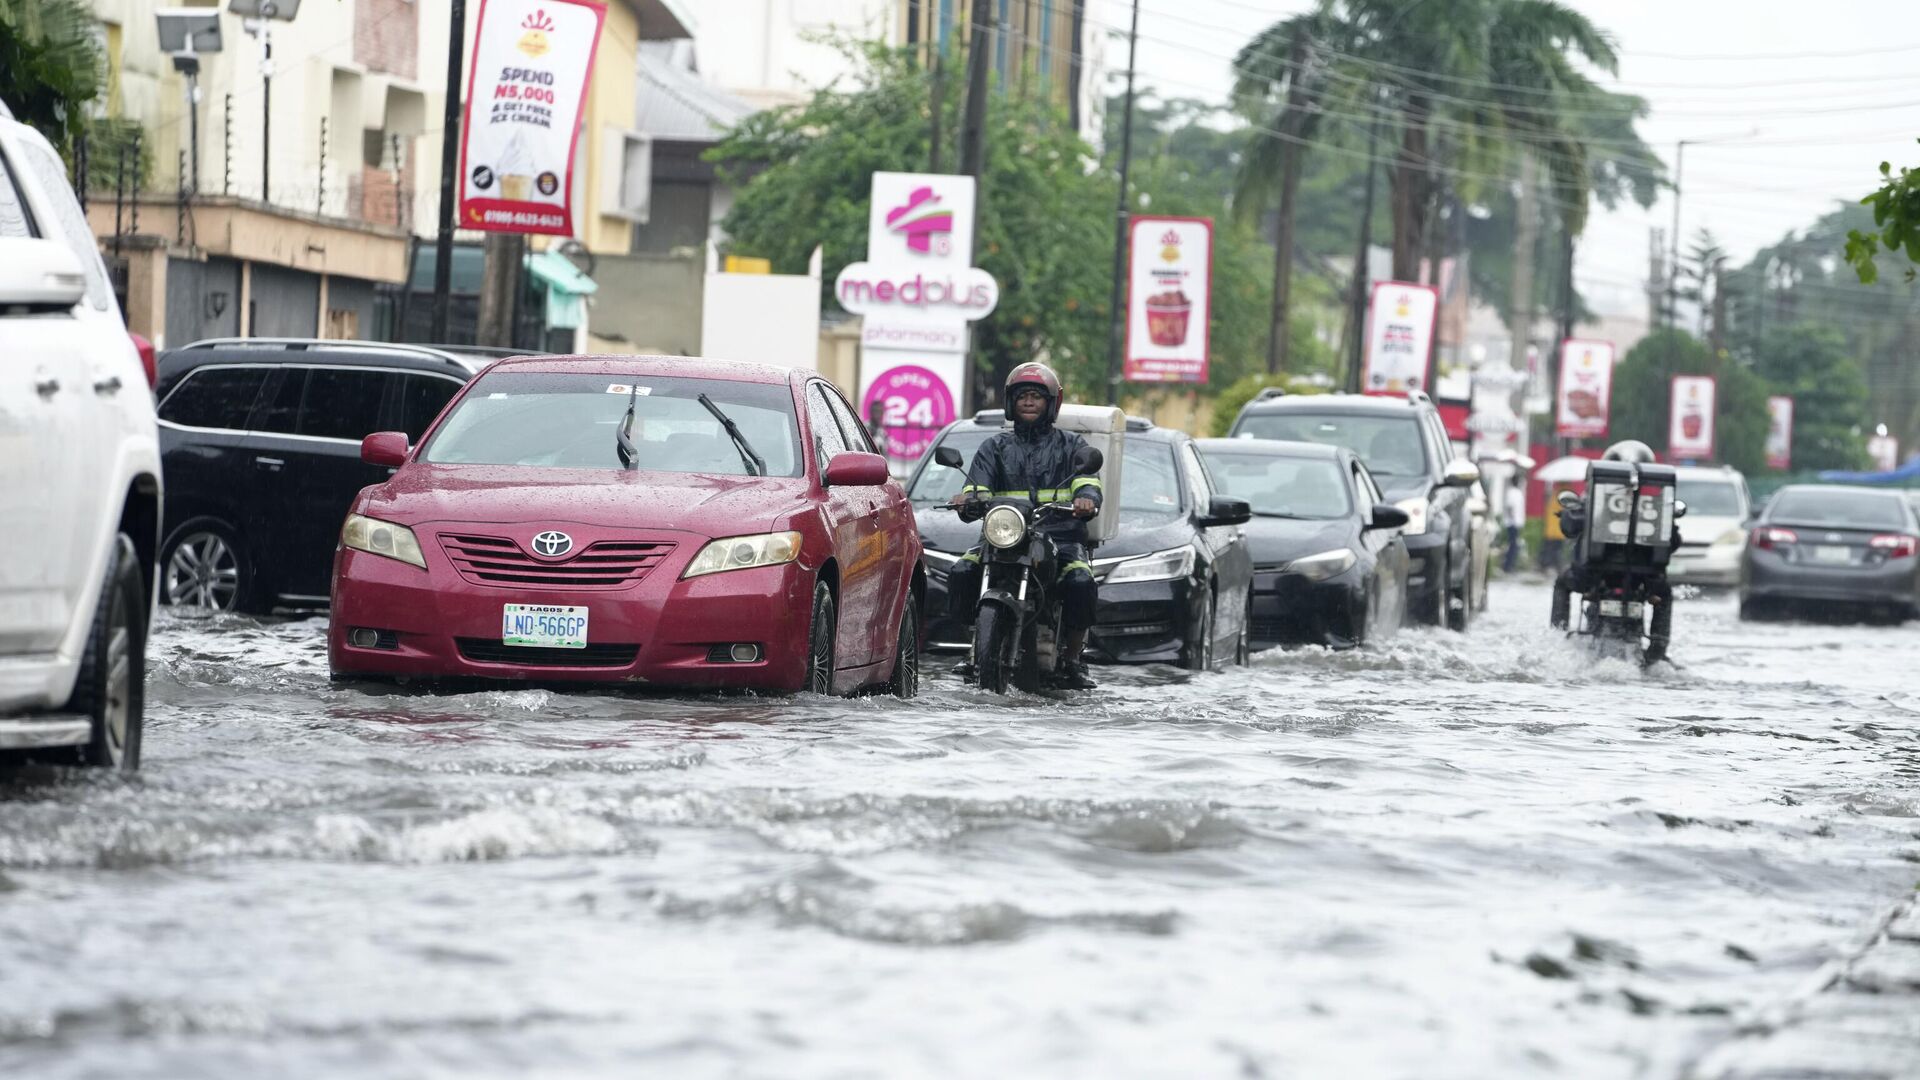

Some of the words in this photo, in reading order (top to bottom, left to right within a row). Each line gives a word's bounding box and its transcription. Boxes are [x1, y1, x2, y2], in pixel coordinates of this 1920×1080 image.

[500, 67, 554, 86] SPEND
[504, 102, 523, 112] GET
[526, 104, 552, 118] FREE
[490, 113, 508, 124] ICE
[512, 114, 552, 129] CREAM
[840, 273, 991, 312] medplus
[865, 325, 958, 346] pharmacy
[889, 373, 931, 390] OPEN
[883, 395, 934, 428] 24
[504, 614, 586, 637] LND-566GP
